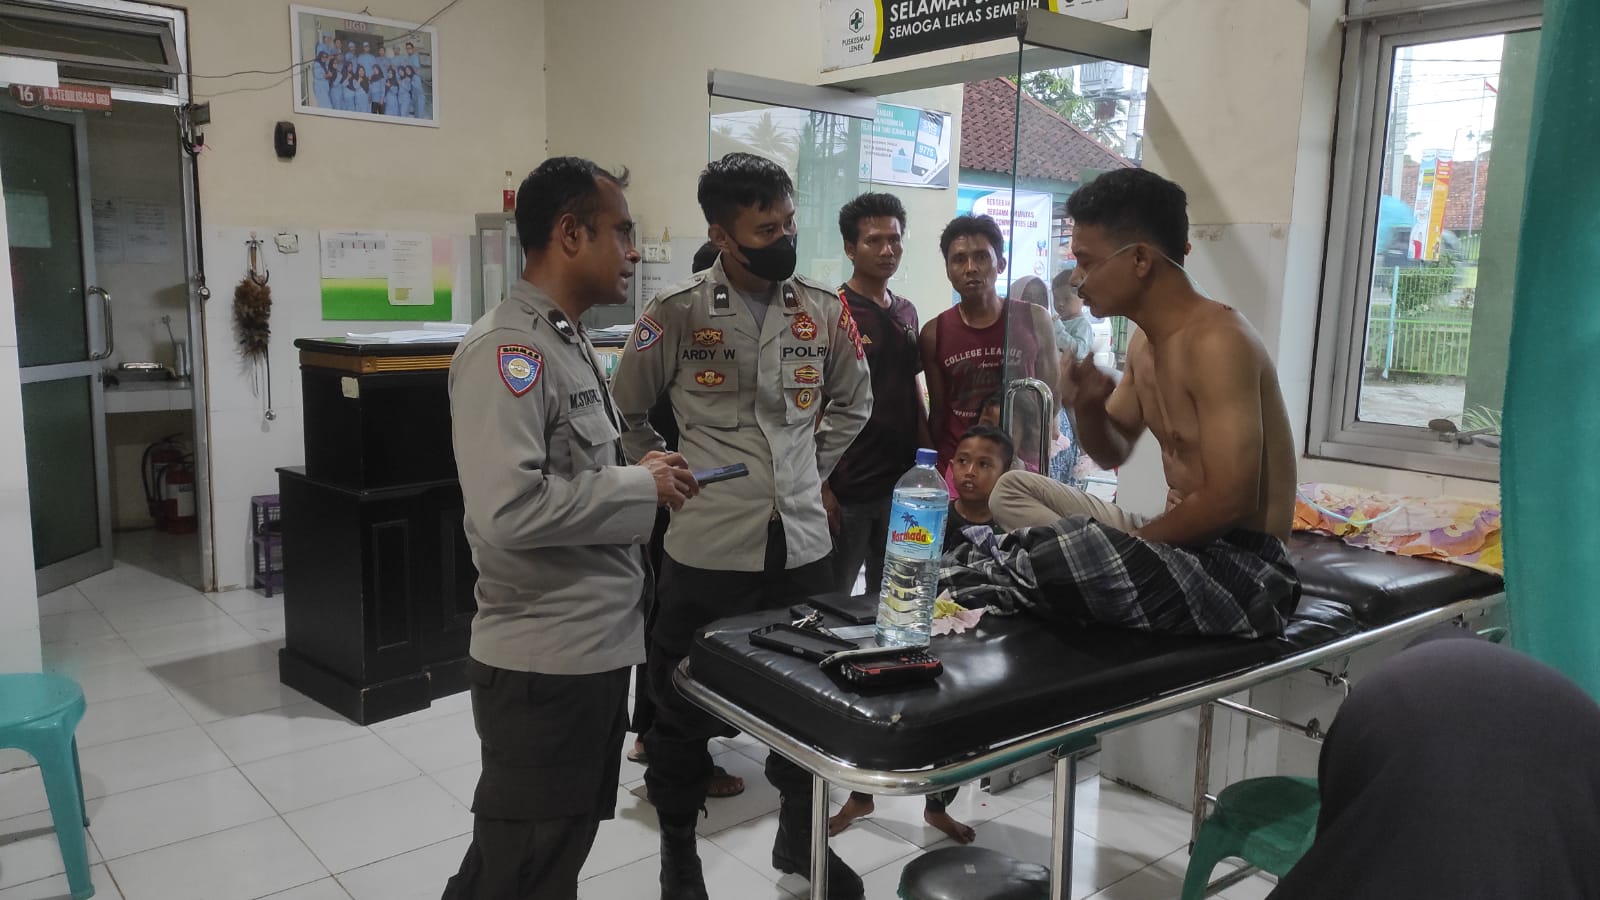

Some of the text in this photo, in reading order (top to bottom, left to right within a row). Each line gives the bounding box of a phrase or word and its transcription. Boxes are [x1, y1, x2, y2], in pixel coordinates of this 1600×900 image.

[890, 17, 941, 39] SEMOGA
[945, 9, 982, 28] LEKAS
[842, 34, 870, 48] PUSKESMAS
[17, 86, 34, 102] 16
[682, 349, 736, 360] ARDY W
[782, 346, 827, 358] POLRI
[944, 348, 982, 367] COLLEGE
[891, 529, 927, 544] Narmada
